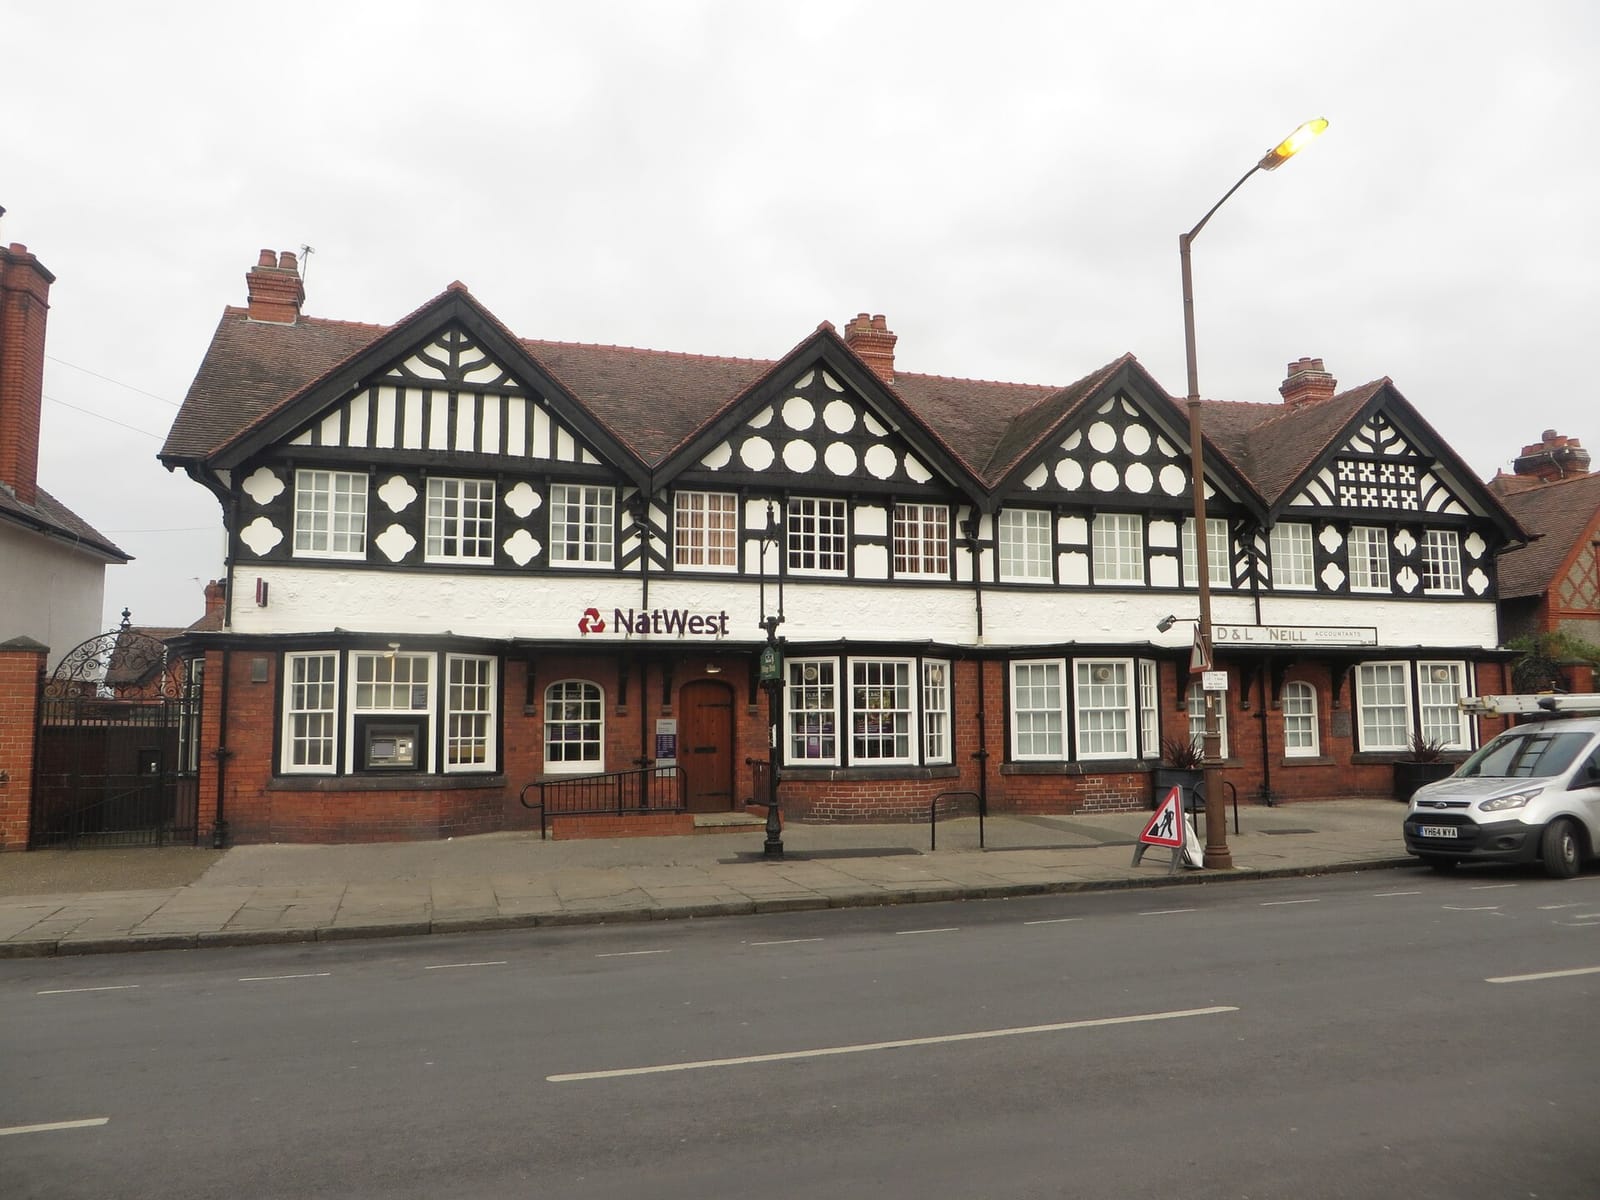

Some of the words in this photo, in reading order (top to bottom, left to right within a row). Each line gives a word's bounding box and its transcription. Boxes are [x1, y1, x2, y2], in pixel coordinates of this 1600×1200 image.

[614, 608, 729, 634] NatWest
[1217, 627, 1228, 640] D
[1232, 629, 1241, 640] &
[1245, 628, 1253, 640] L
